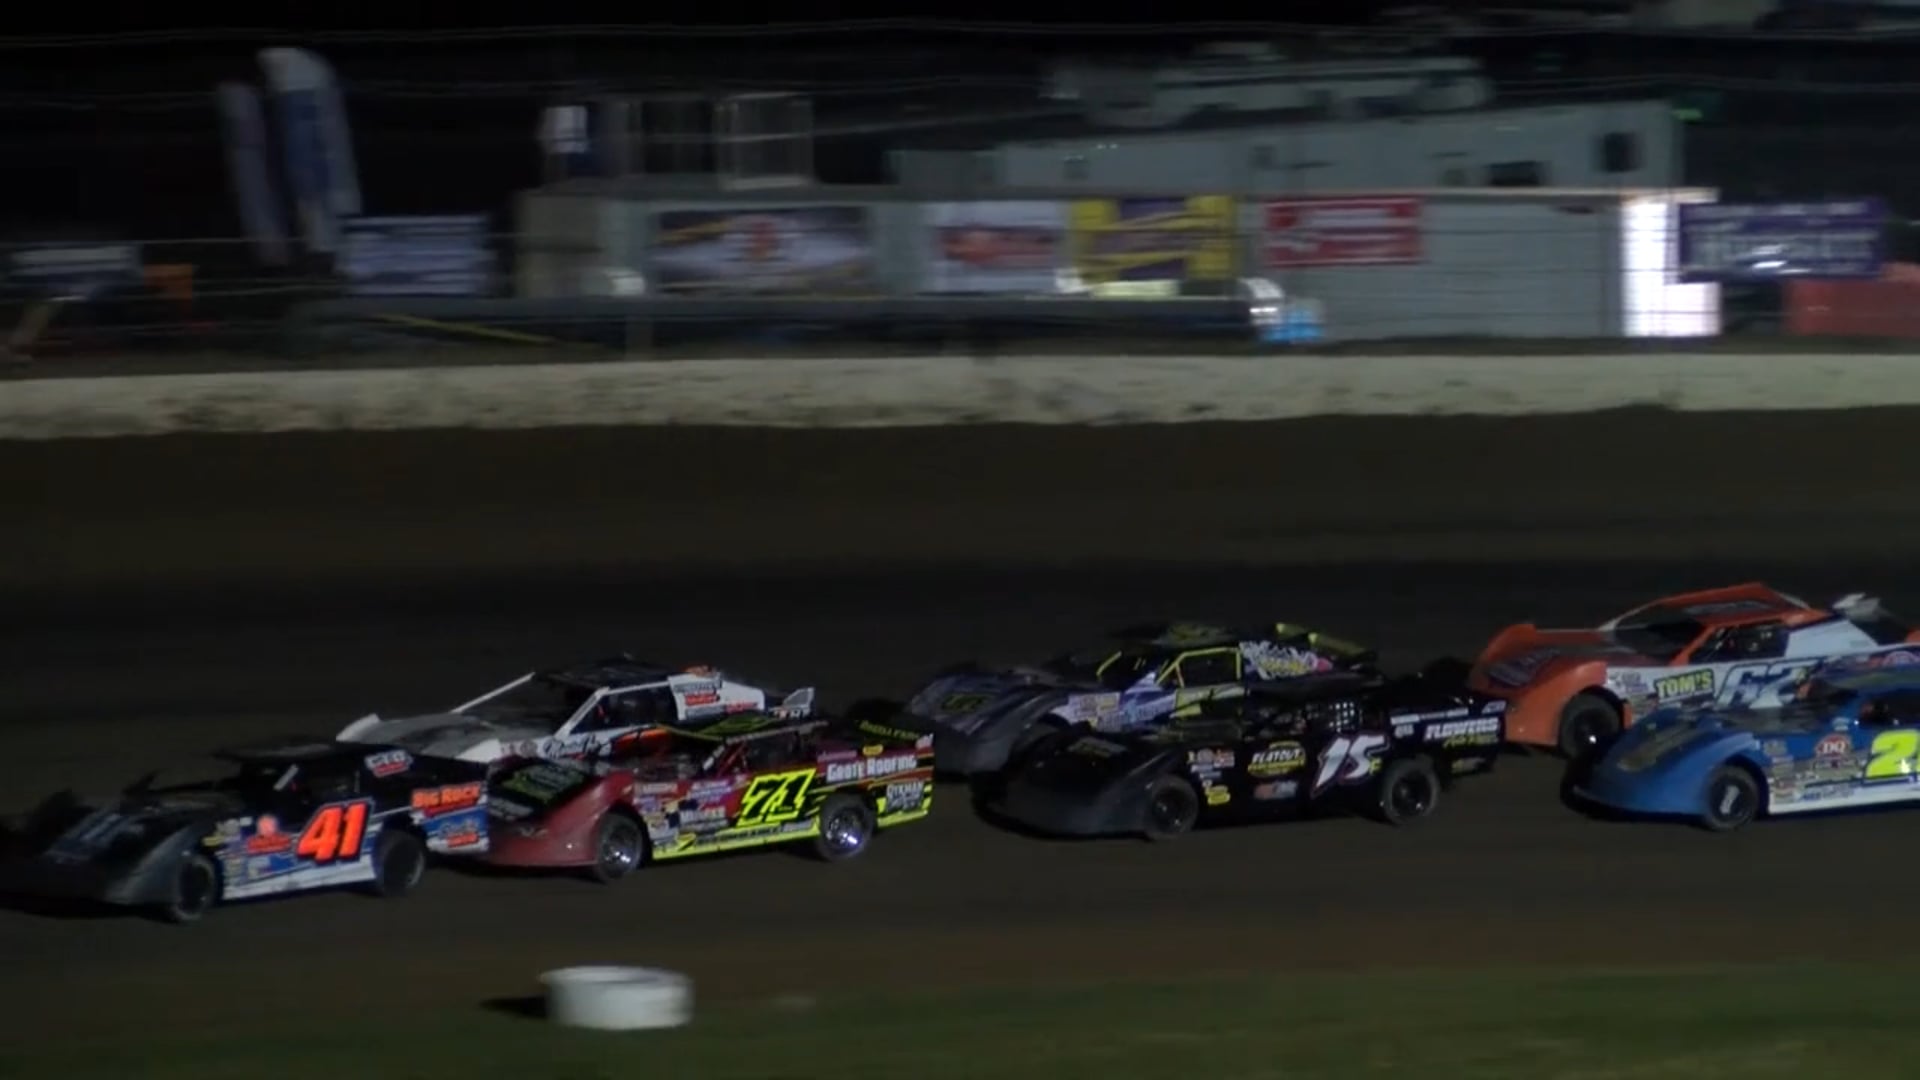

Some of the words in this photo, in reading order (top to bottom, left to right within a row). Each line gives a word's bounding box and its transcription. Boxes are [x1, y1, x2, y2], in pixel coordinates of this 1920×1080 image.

[1655, 671, 1712, 698] TOM'S
[1313, 734, 1388, 790] 15
[1865, 730, 1920, 778] 2
[736, 768, 817, 827] 71
[296, 800, 369, 864] 41
